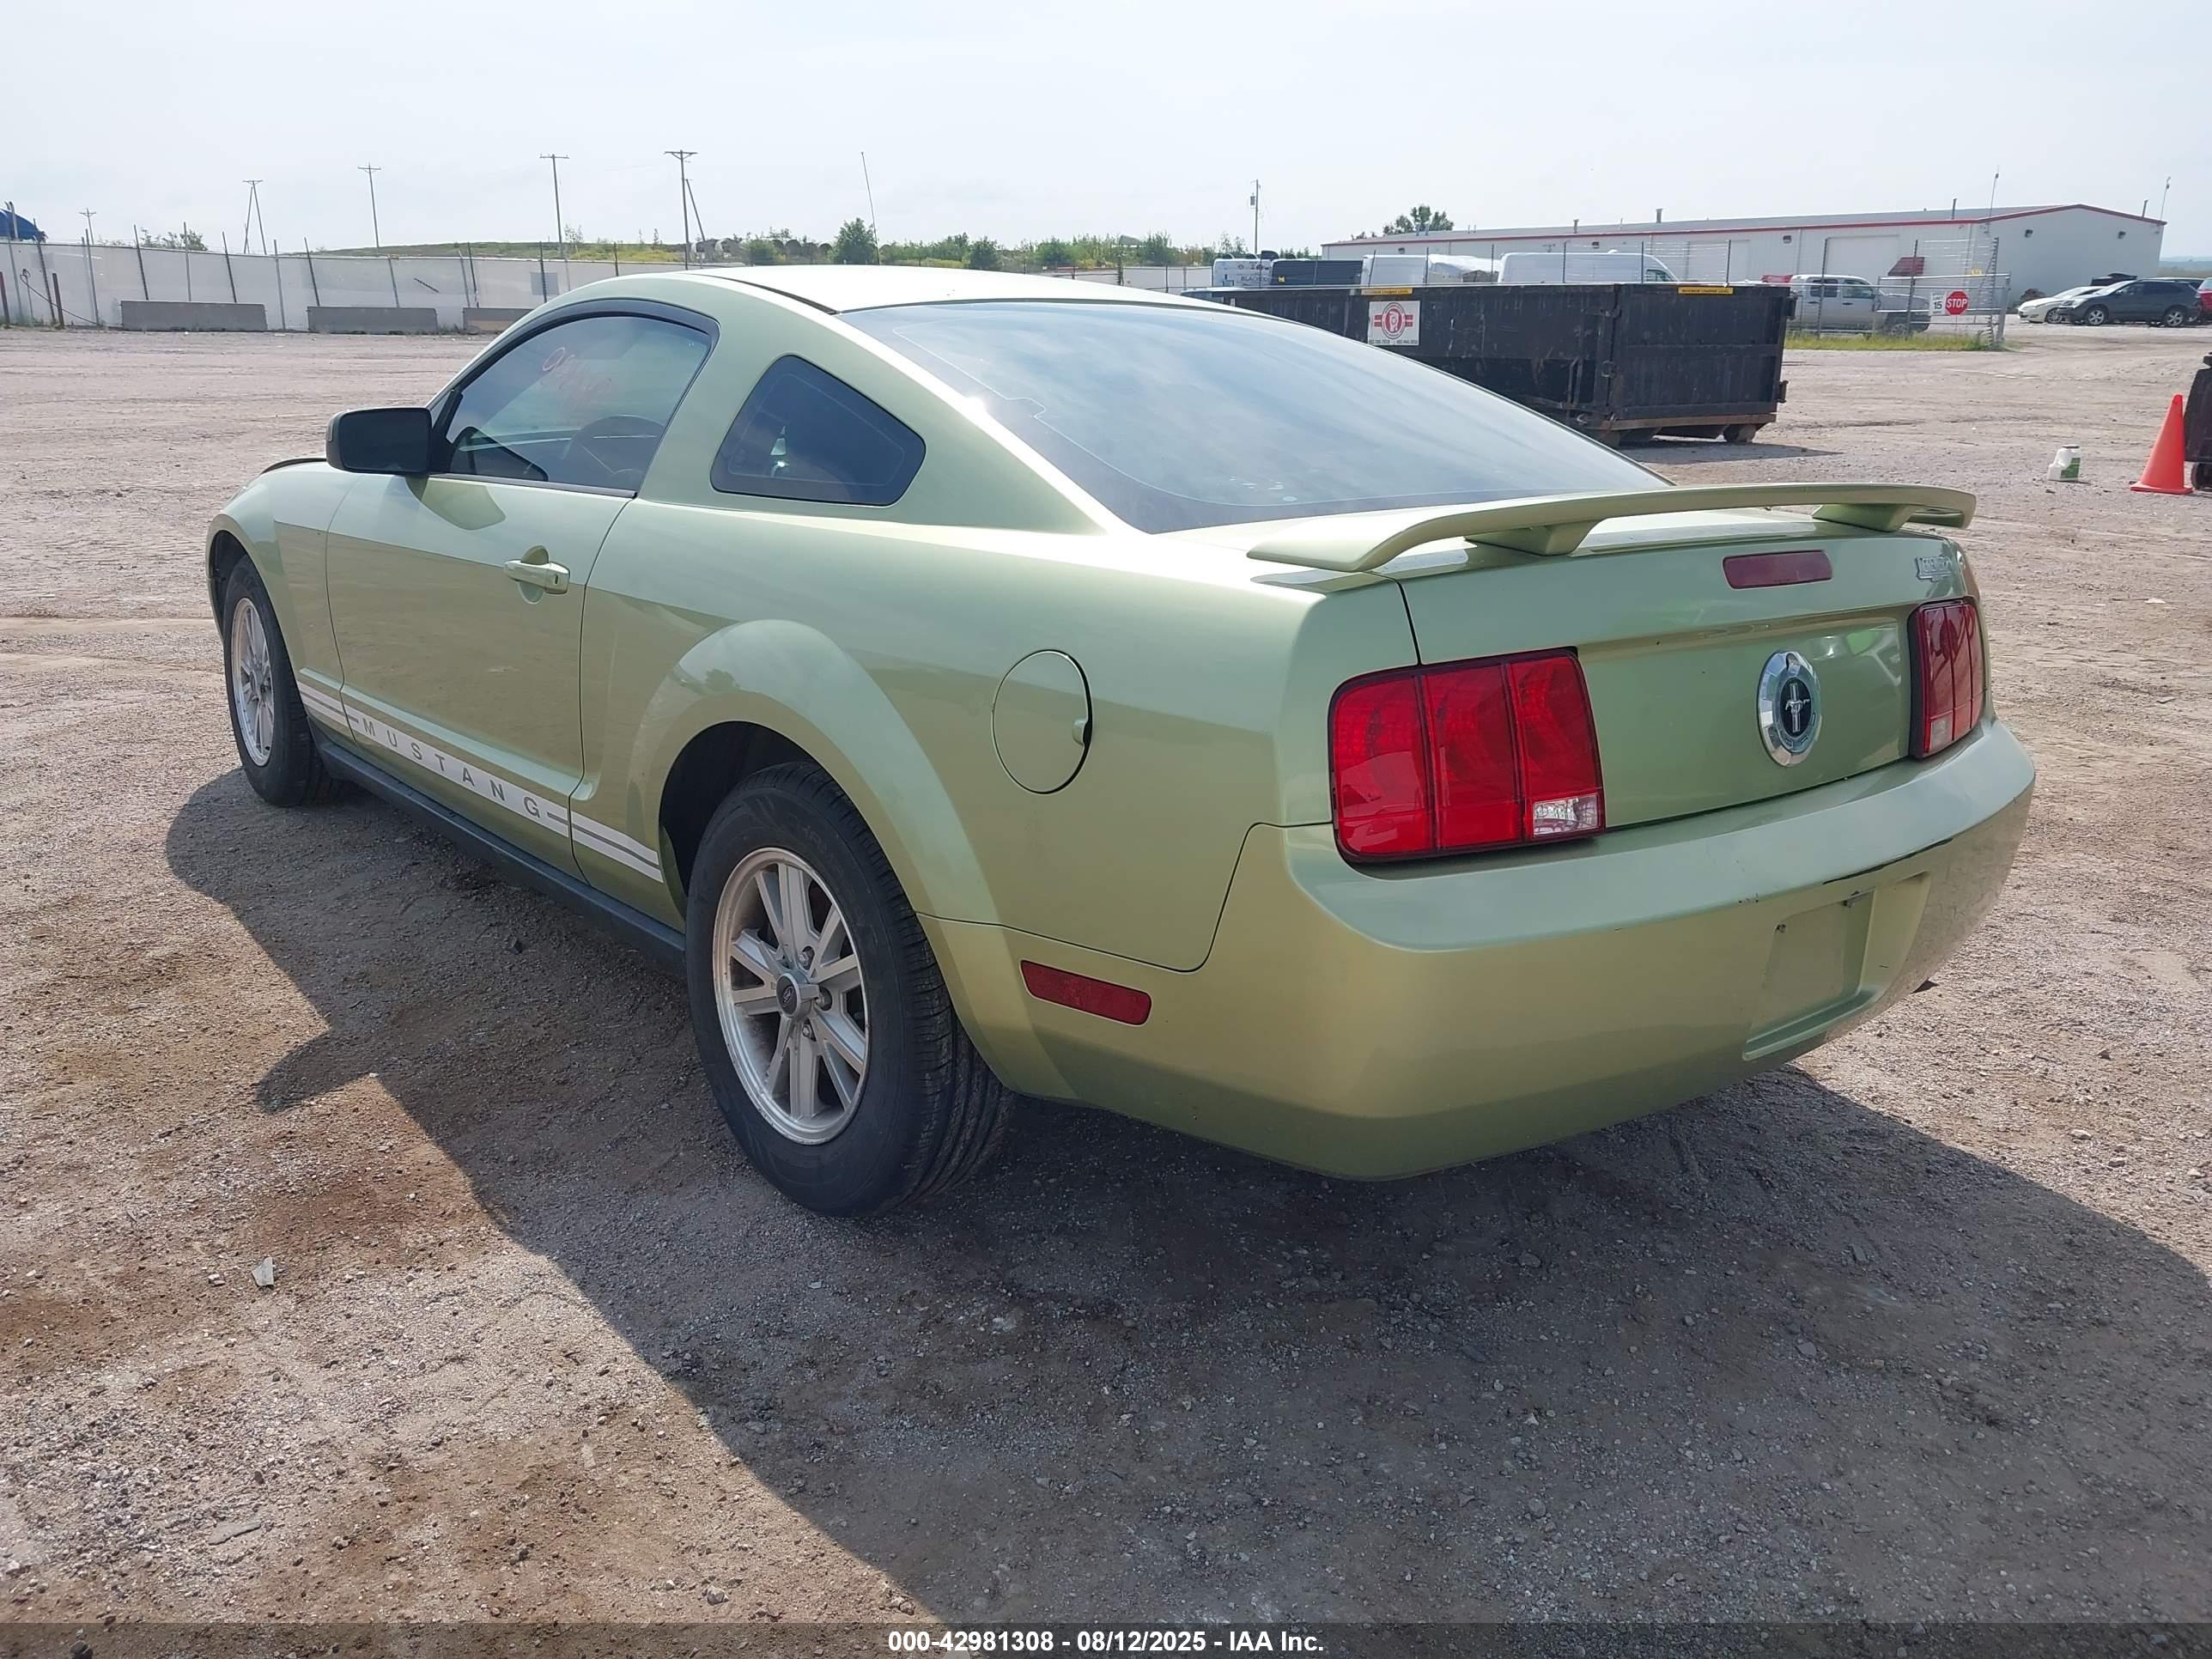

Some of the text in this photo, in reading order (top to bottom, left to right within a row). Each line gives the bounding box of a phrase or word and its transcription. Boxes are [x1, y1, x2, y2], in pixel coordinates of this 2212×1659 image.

[1933, 301, 1943, 310] 15
[1946, 298, 1968, 309] STOP
[362, 717, 541, 818] MUSTANG
